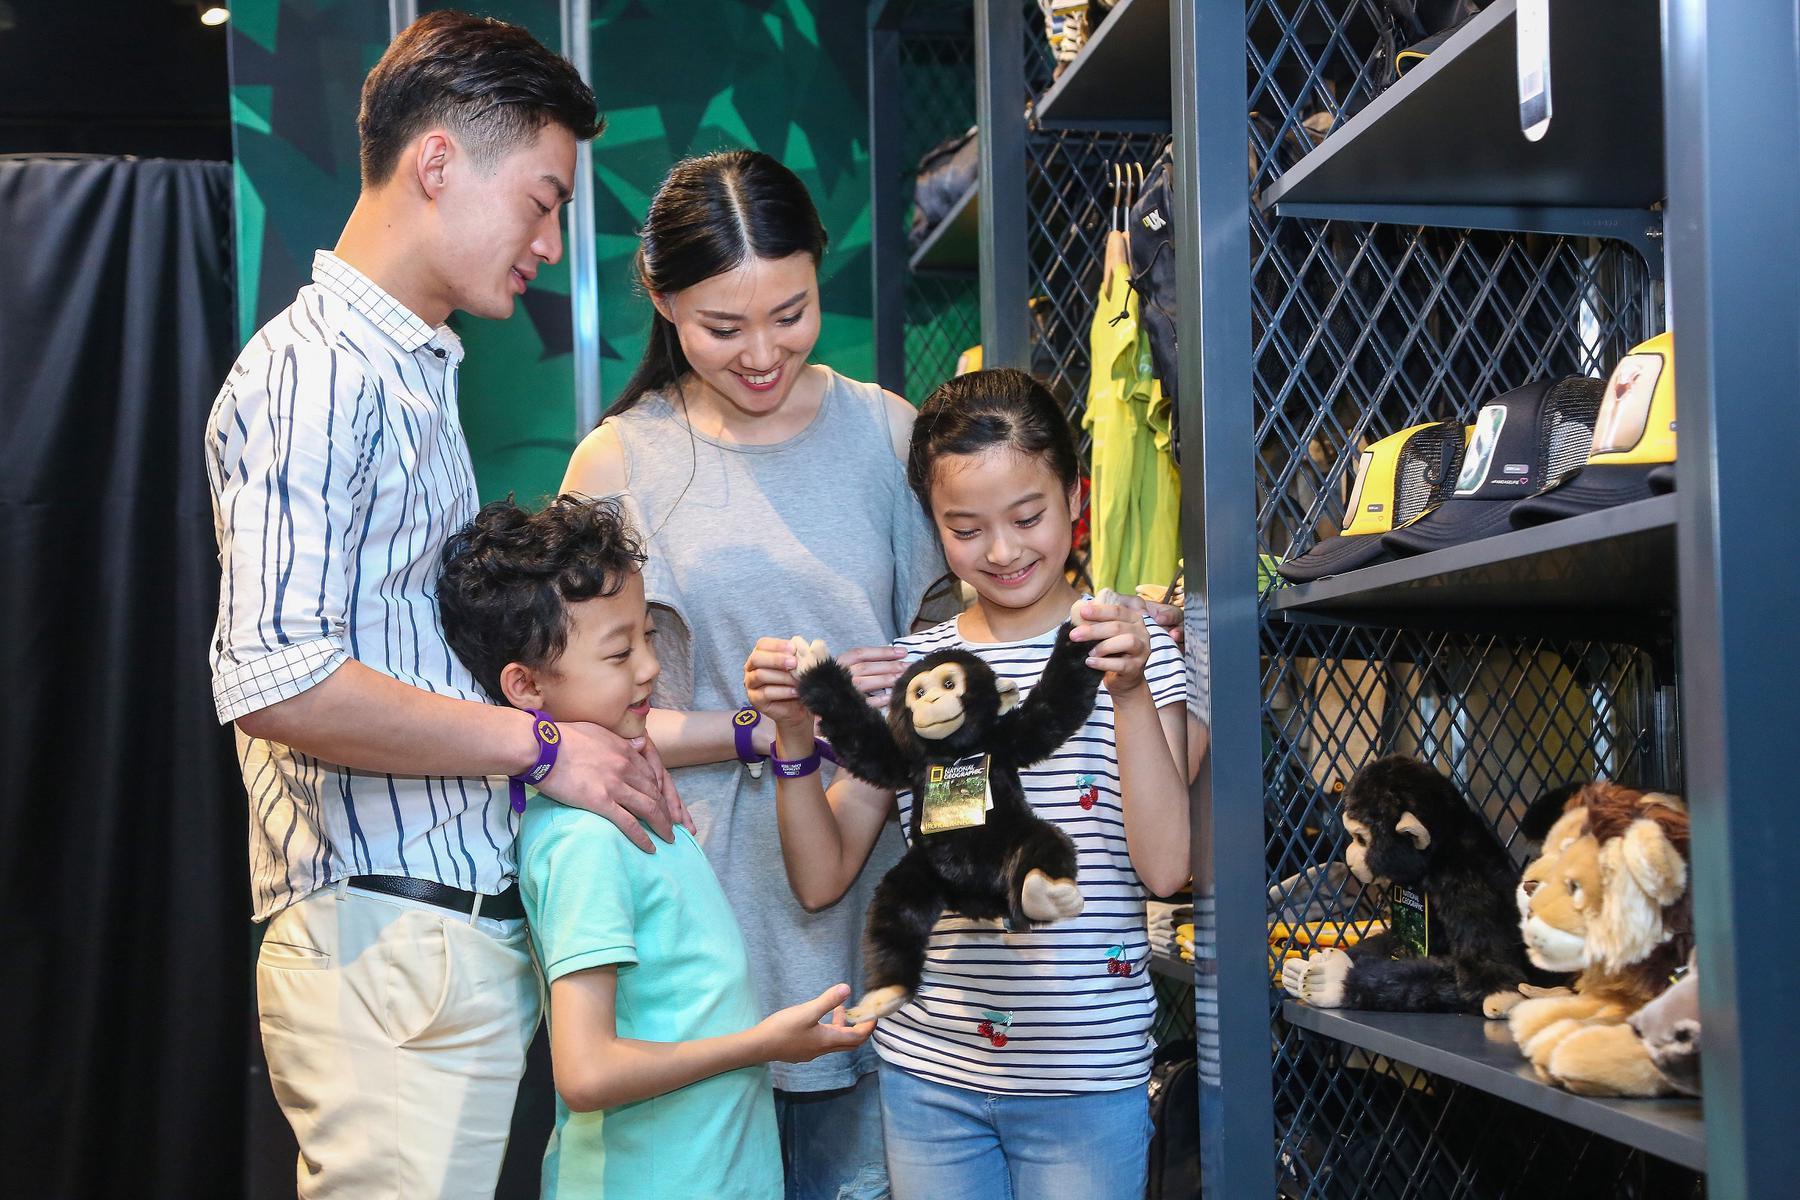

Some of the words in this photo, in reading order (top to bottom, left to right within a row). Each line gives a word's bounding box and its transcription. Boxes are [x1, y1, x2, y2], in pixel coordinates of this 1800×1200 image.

[943, 767, 985, 780] GEOGRAPHIC
[944, 764, 976, 775] NATIONAL
[1402, 889, 1420, 903] NATIONAL
[1401, 896, 1424, 912] GEOGRAPHIC
